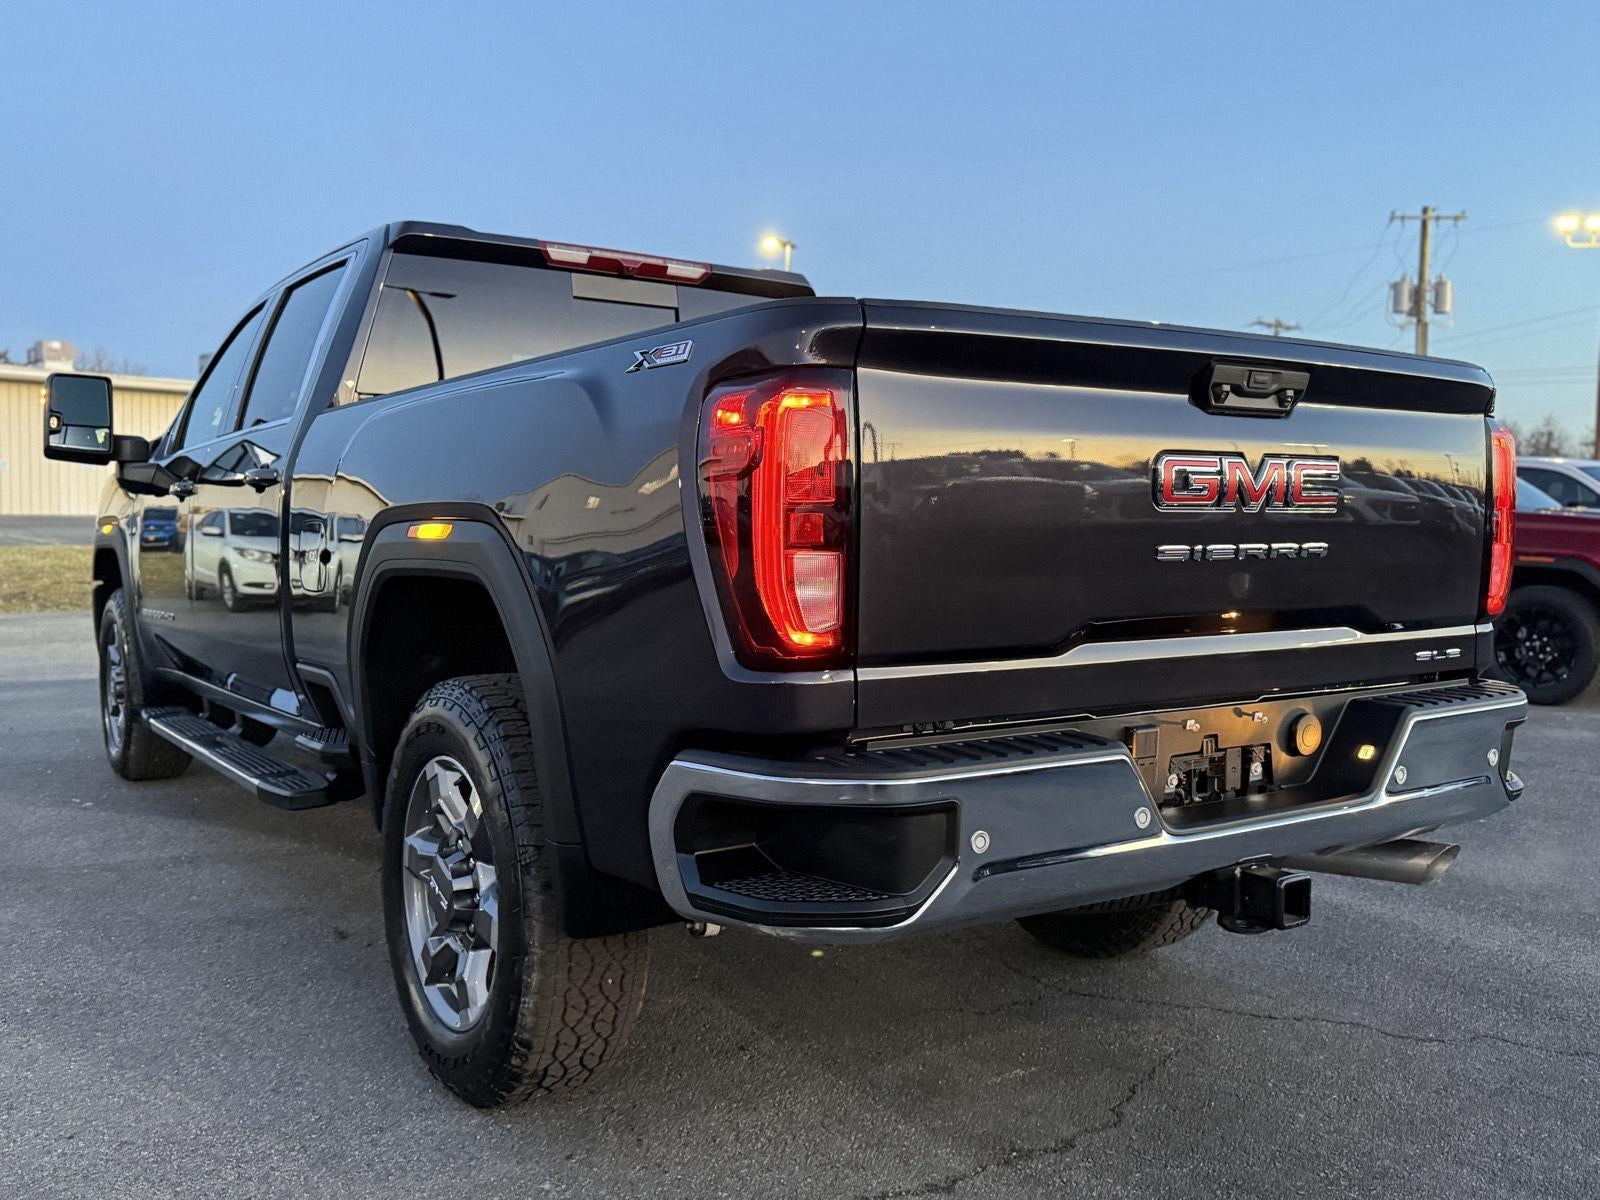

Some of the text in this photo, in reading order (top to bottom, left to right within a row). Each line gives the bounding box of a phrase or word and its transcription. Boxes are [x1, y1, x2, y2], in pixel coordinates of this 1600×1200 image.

[625, 340, 694, 373] X31
[1153, 450, 1340, 513] GMC
[1156, 542, 1329, 562] SIERRA
